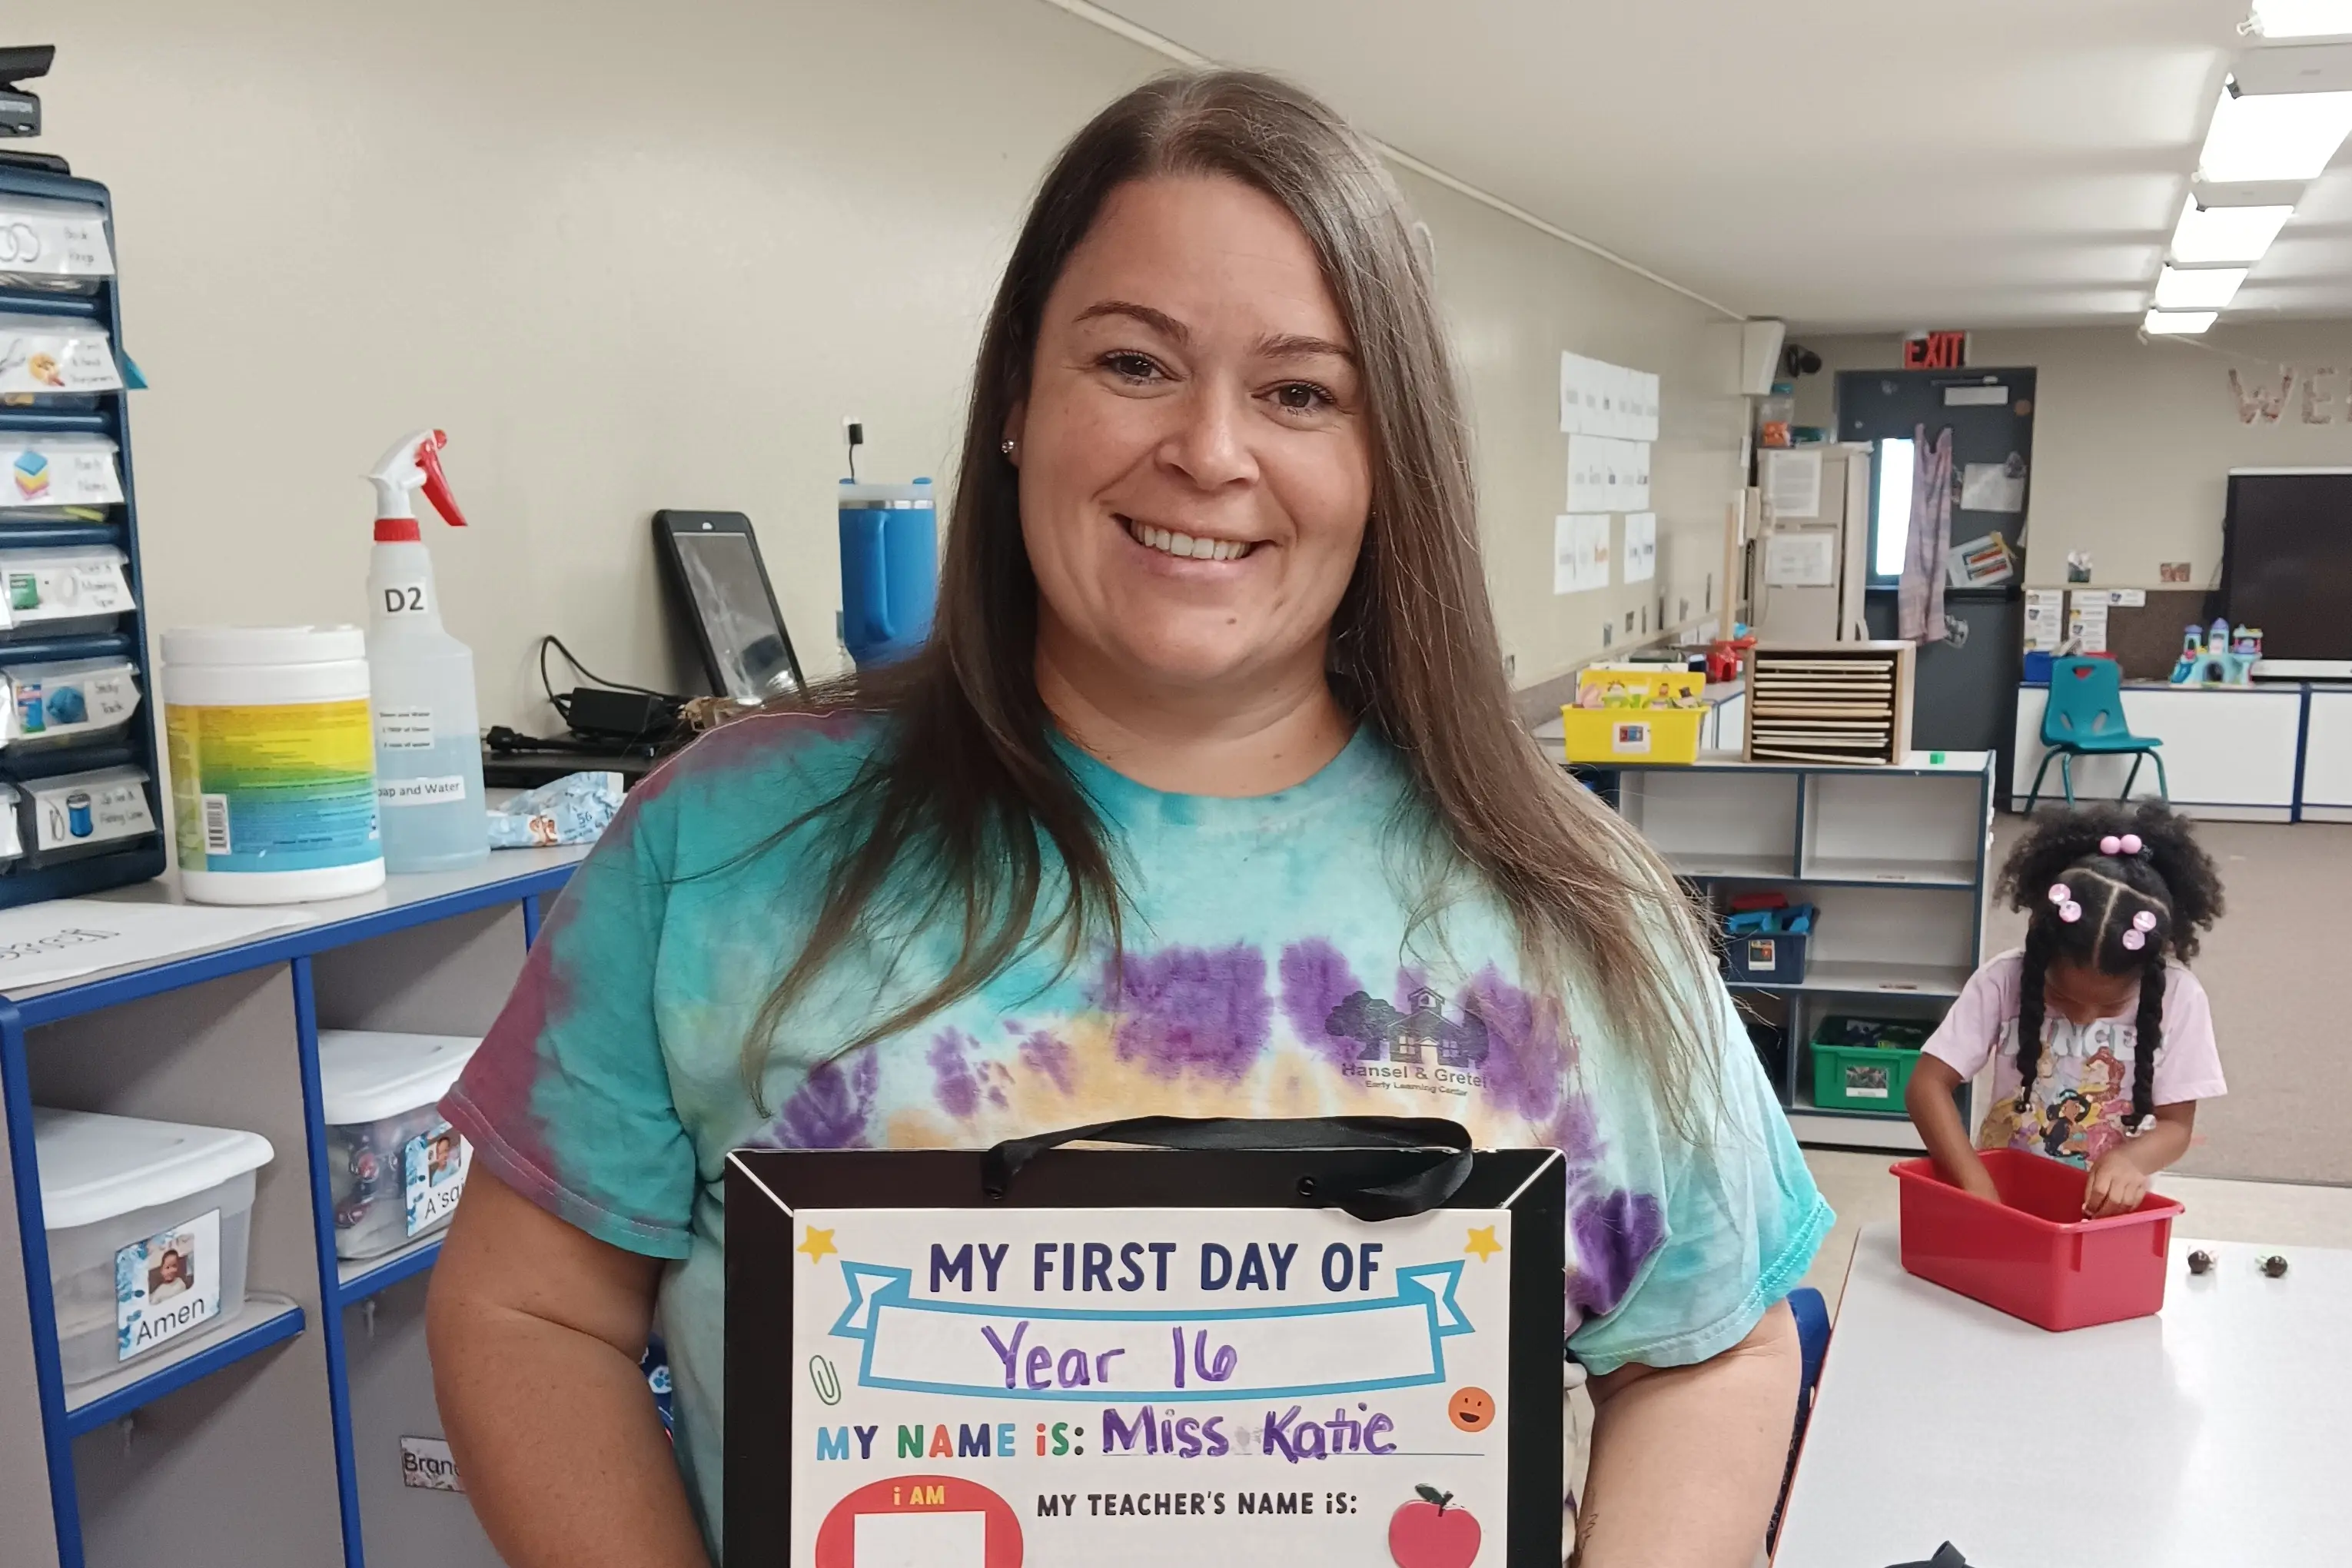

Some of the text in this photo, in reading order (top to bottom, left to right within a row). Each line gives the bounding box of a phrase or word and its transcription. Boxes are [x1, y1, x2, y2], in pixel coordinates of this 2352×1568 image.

[1905, 332, 1964, 369] EXIT
[2228, 367, 2352, 424] WE
[384, 586, 424, 613] D2
[399, 785, 422, 796] and
[425, 782, 460, 794] Water
[1341, 1063, 1487, 1088] Hansel & Gretel
[1365, 1081, 1467, 1096] Early Learning Center
[425, 1178, 465, 1219] A'sa
[929, 1242, 1384, 1292] MY FIRST DAY OF
[136, 1297, 205, 1346] Amen
[981, 1321, 1237, 1390] Year 16
[816, 1425, 879, 1460] MY
[898, 1423, 1016, 1458] NAME
[1102, 1402, 1397, 1463] Miss Katie
[909, 1485, 945, 1505] AM
[1037, 1493, 1077, 1517] MY
[1087, 1491, 1225, 1516] TEACHER'S
[1237, 1492, 1313, 1515] NAME
